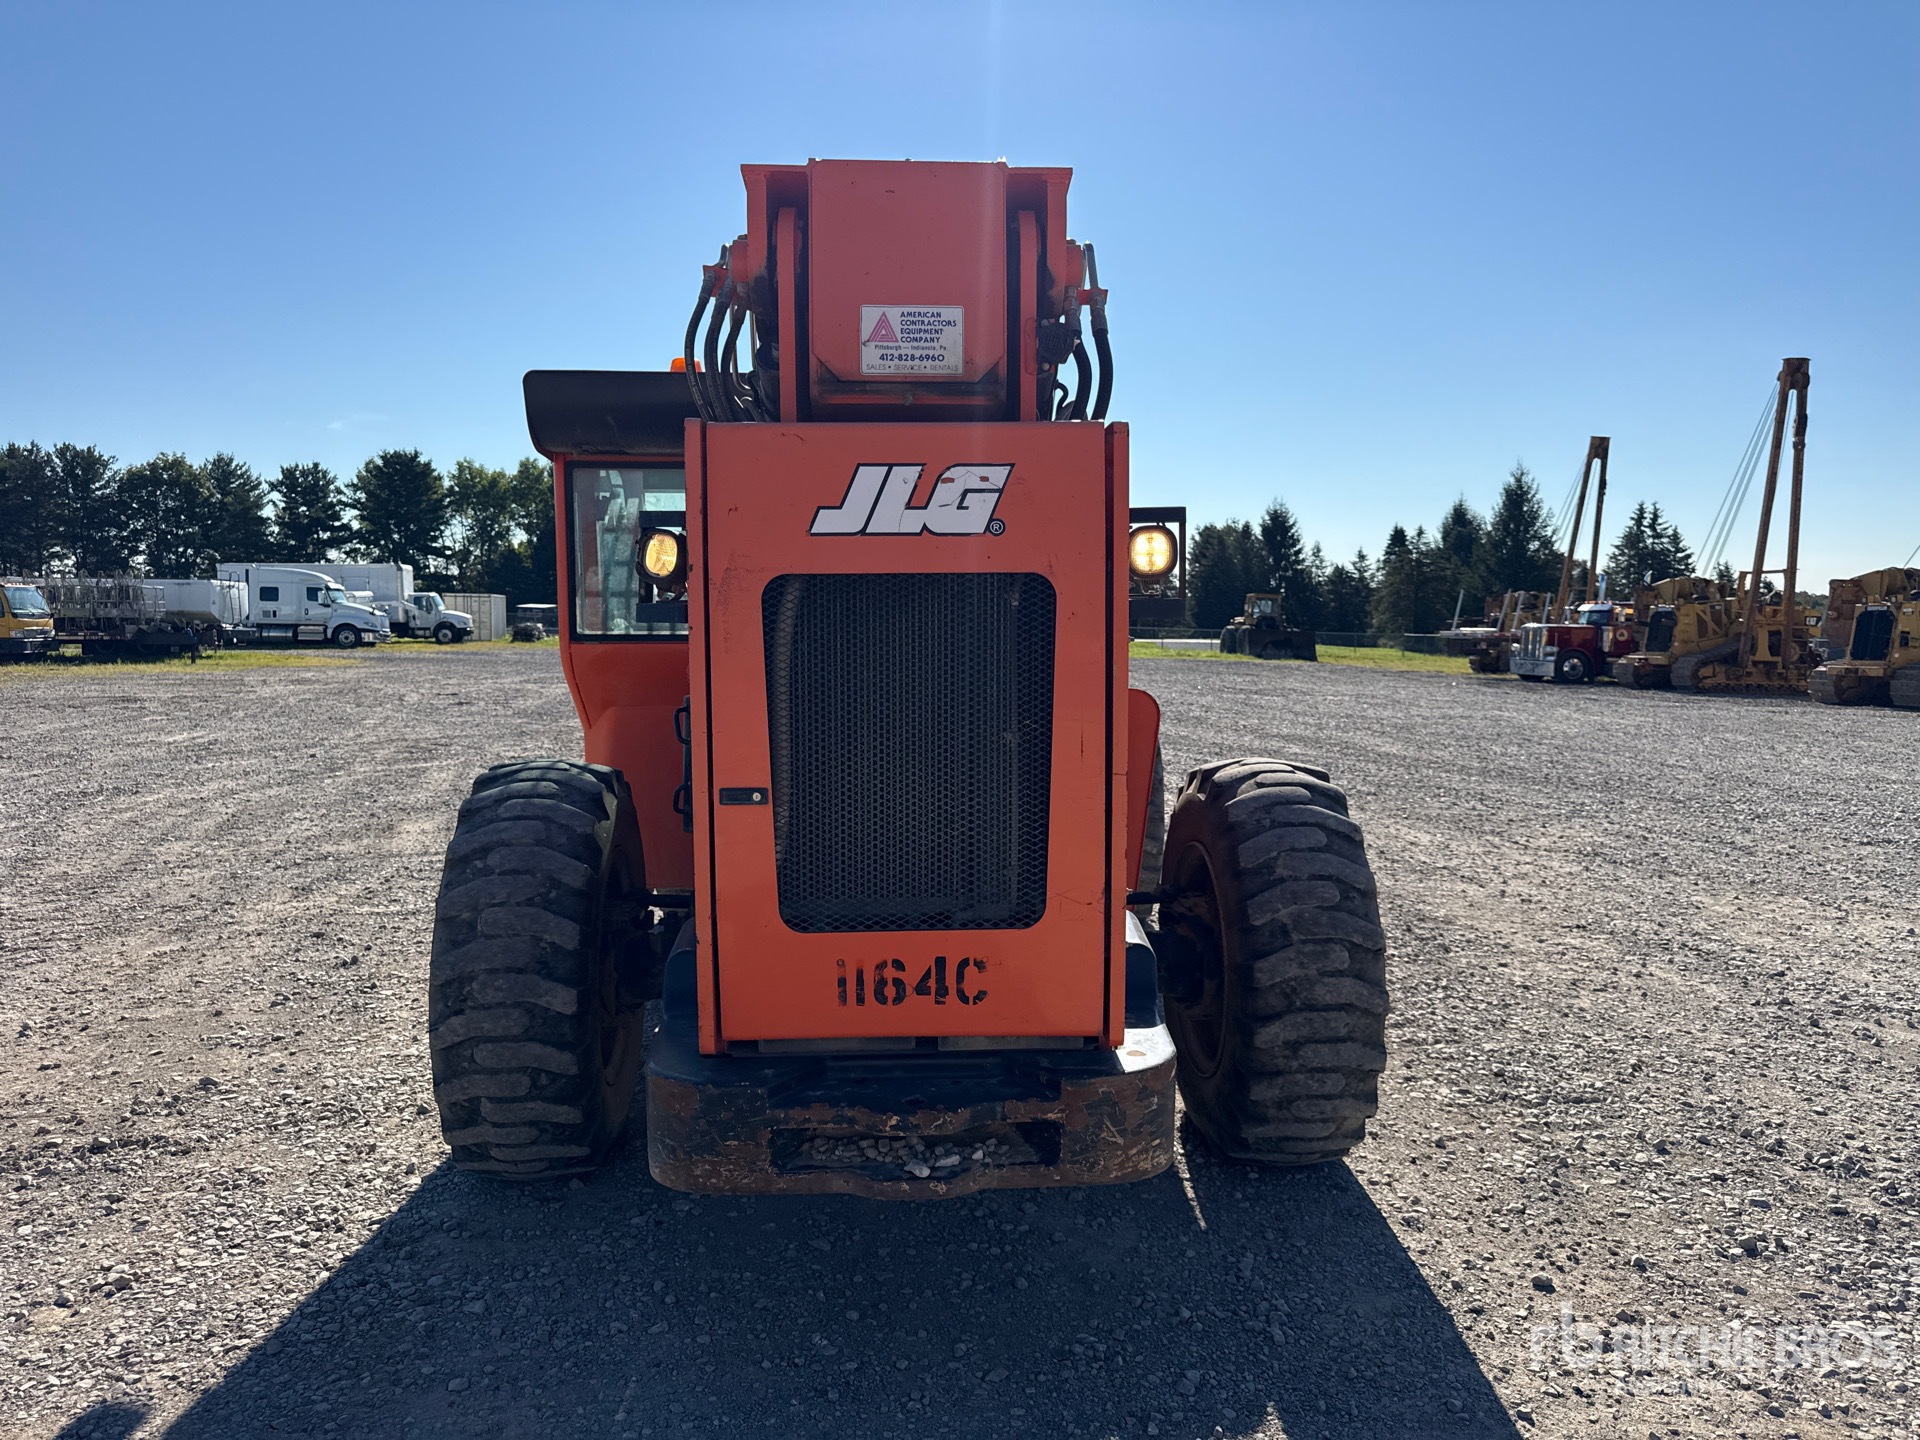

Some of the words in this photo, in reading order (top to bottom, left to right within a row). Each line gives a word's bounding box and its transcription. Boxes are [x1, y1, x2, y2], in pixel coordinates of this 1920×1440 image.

[900, 311, 942, 319] AMERICAN
[900, 319, 957, 327] CONTRACTORS
[900, 328, 944, 336] EQUIPMENT
[900, 336, 941, 344] COMPANY
[874, 344, 902, 352] Pittsburgh
[879, 353, 945, 362] 412-828-6960
[866, 363, 887, 371] SALES
[929, 364, 959, 372] RENTALS
[807, 463, 1015, 537] JLG
